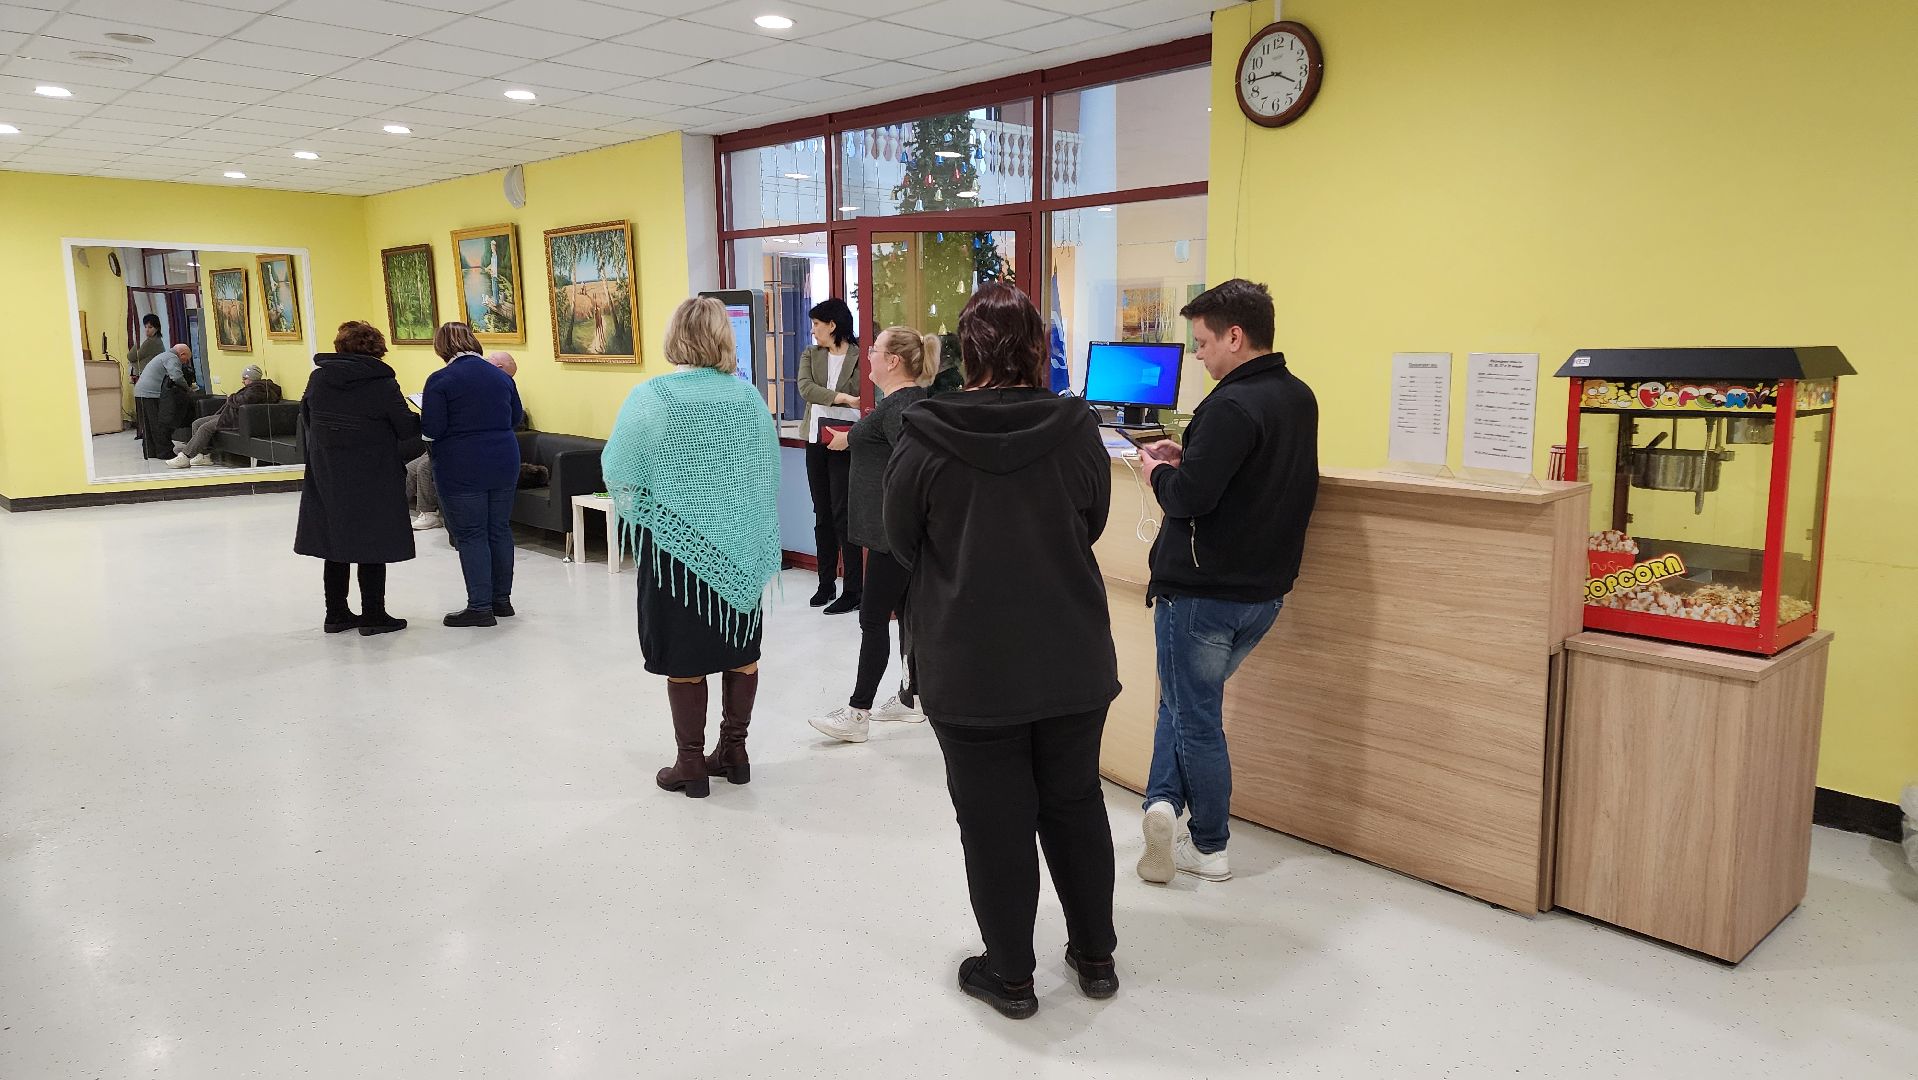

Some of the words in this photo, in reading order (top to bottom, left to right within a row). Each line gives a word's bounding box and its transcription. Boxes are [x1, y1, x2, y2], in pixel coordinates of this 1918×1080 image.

[1274, 37, 1284, 49] 12
[1290, 37, 1295, 50] 1
[1262, 44, 1270, 55] 11
[1297, 49, 1304, 61] 2
[1252, 57, 1263, 70] 10
[1300, 64, 1307, 77] 3
[1248, 72, 1256, 84] 9
[1294, 79, 1303, 91] 4
[1251, 86, 1259, 98] 8
[1261, 96, 1268, 110] 7
[1285, 93, 1293, 105] 5
[1272, 99, 1279, 112] 6
